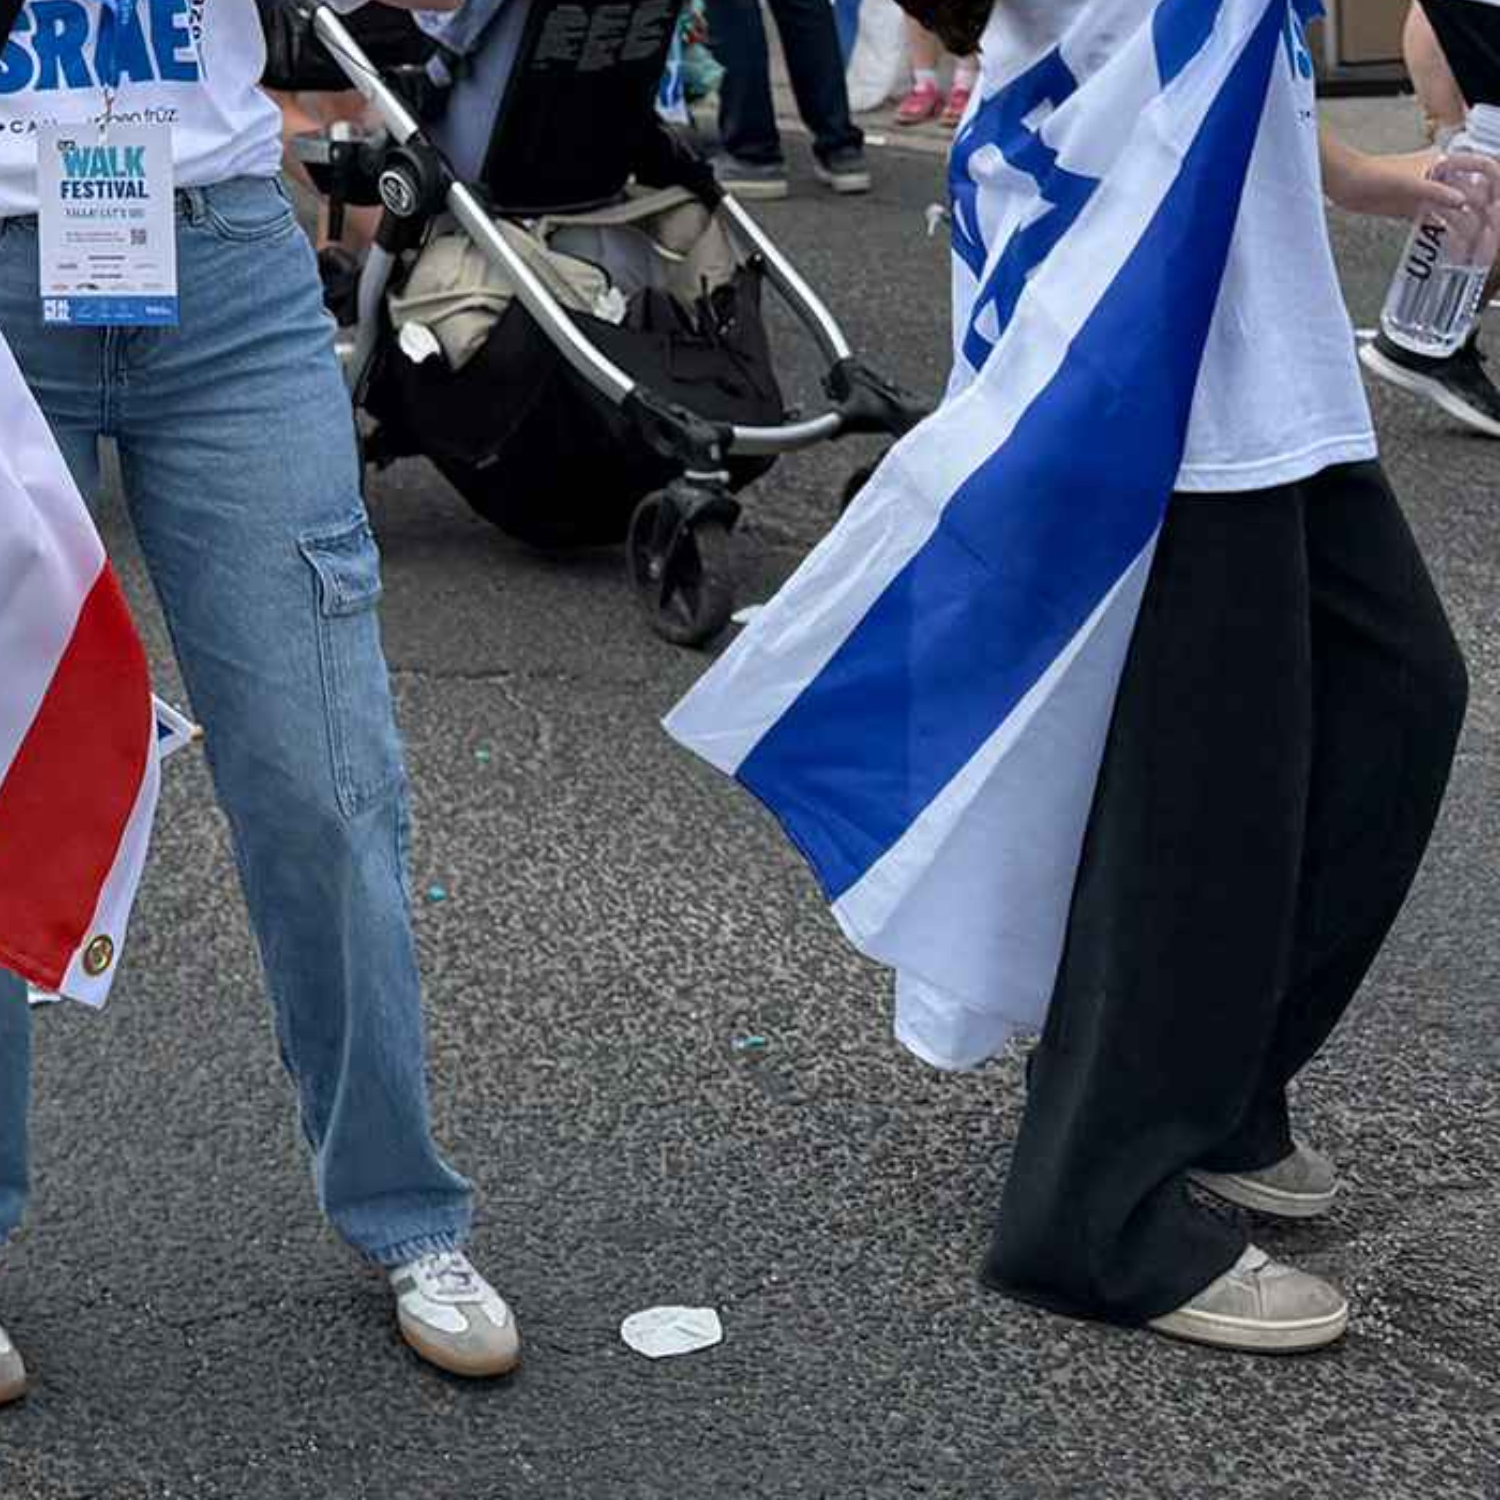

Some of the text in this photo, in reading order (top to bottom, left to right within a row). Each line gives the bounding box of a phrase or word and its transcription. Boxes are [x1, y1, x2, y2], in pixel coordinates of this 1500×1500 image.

[62, 146, 146, 178] WALK
[61, 180, 150, 200] FESTIVAL
[1406, 224, 1447, 281] UJA
